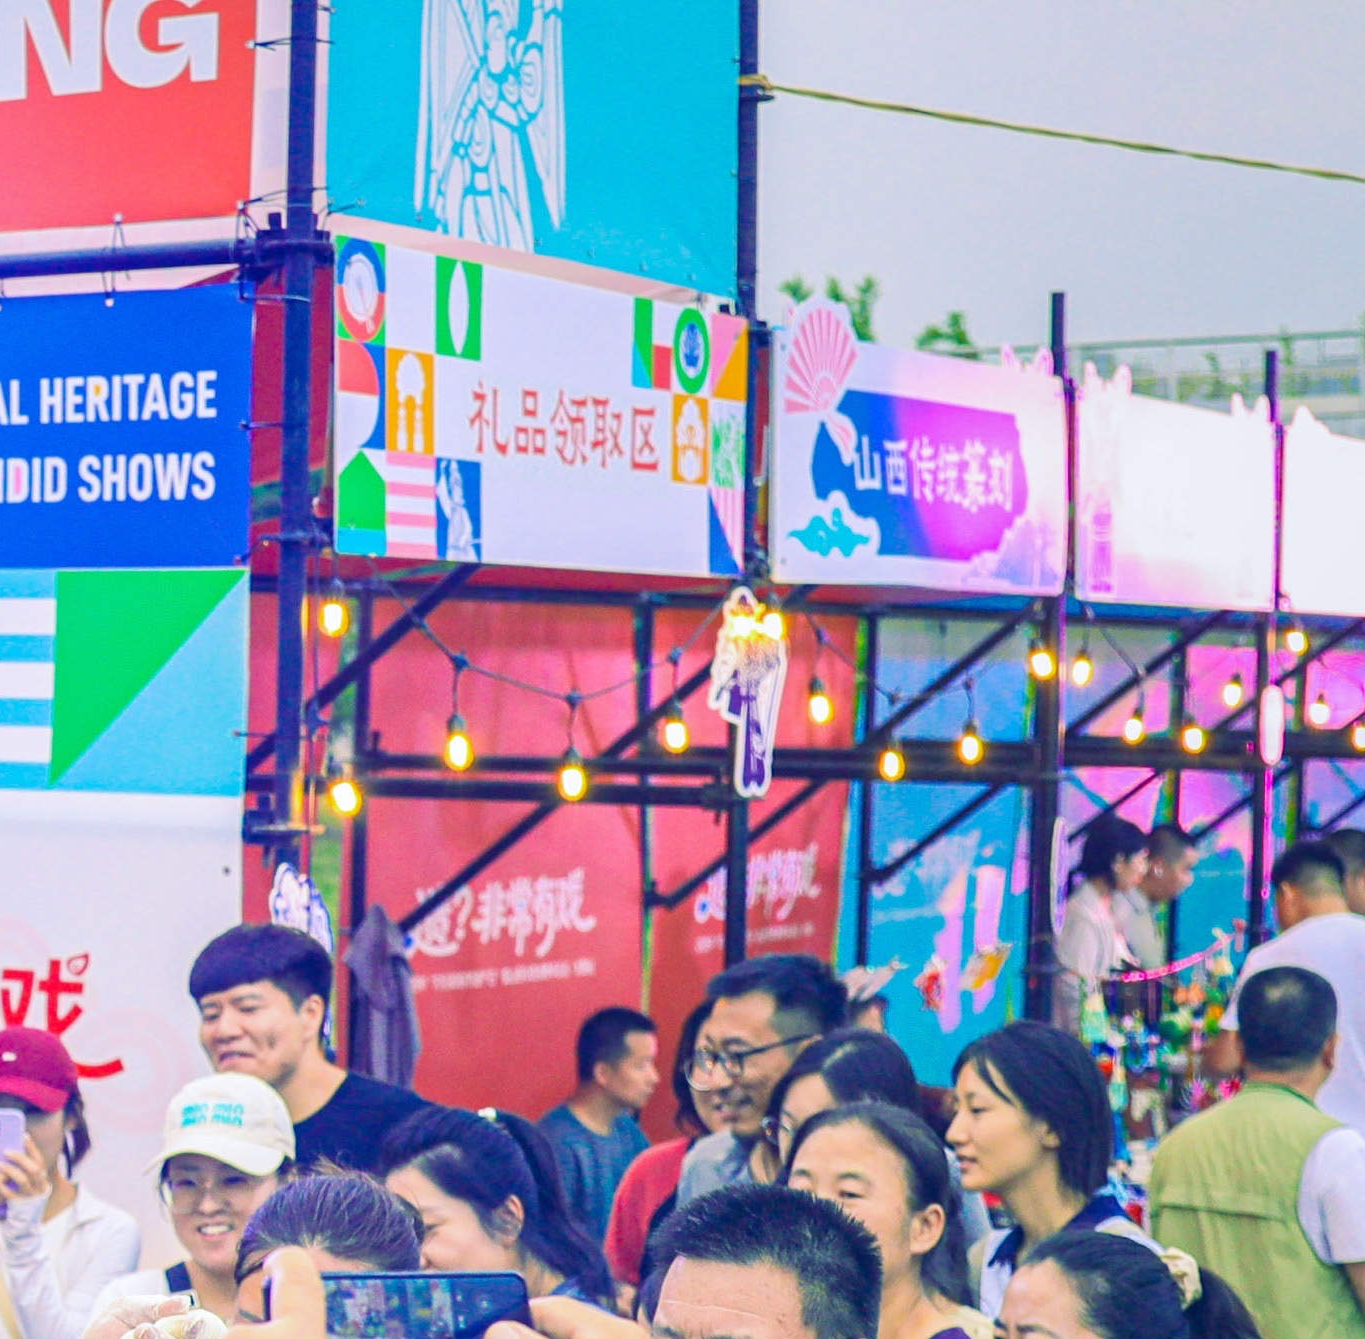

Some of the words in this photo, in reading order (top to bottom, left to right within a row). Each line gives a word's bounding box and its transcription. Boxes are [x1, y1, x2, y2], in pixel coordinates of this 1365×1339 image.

[42, 370, 218, 425] HERITAGE
[469, 380, 661, 473] 礼品领取区
[78, 451, 217, 502] SHOWS
